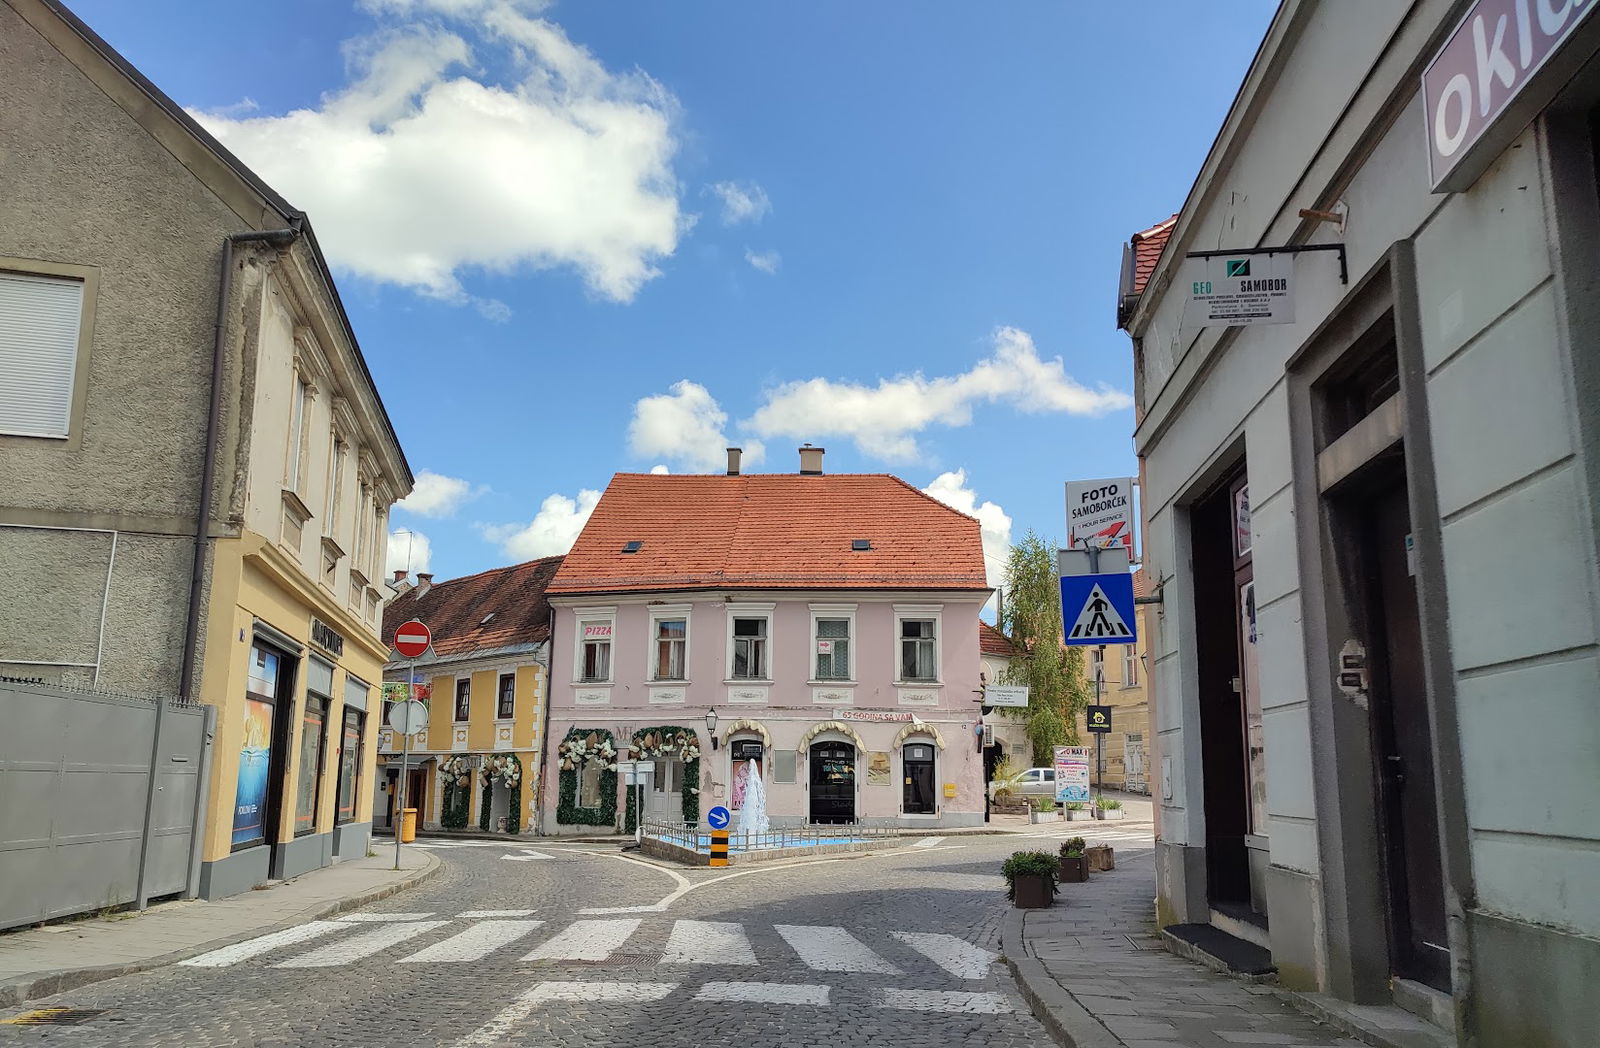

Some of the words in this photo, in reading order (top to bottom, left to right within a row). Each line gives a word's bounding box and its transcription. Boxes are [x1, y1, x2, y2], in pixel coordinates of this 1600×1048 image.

[1193, 281, 1211, 294] GEO
[1240, 278, 1287, 292] SAMOBOR
[1081, 484, 1118, 503] FOTO
[1072, 496, 1127, 519] SAMOBORČEK
[1082, 520, 1098, 528] HOUR
[1100, 513, 1122, 523] SERVICE
[584, 626, 612, 636] PIZZA
[852, 712, 883, 721] GODINA
[884, 713, 894, 721] SA
